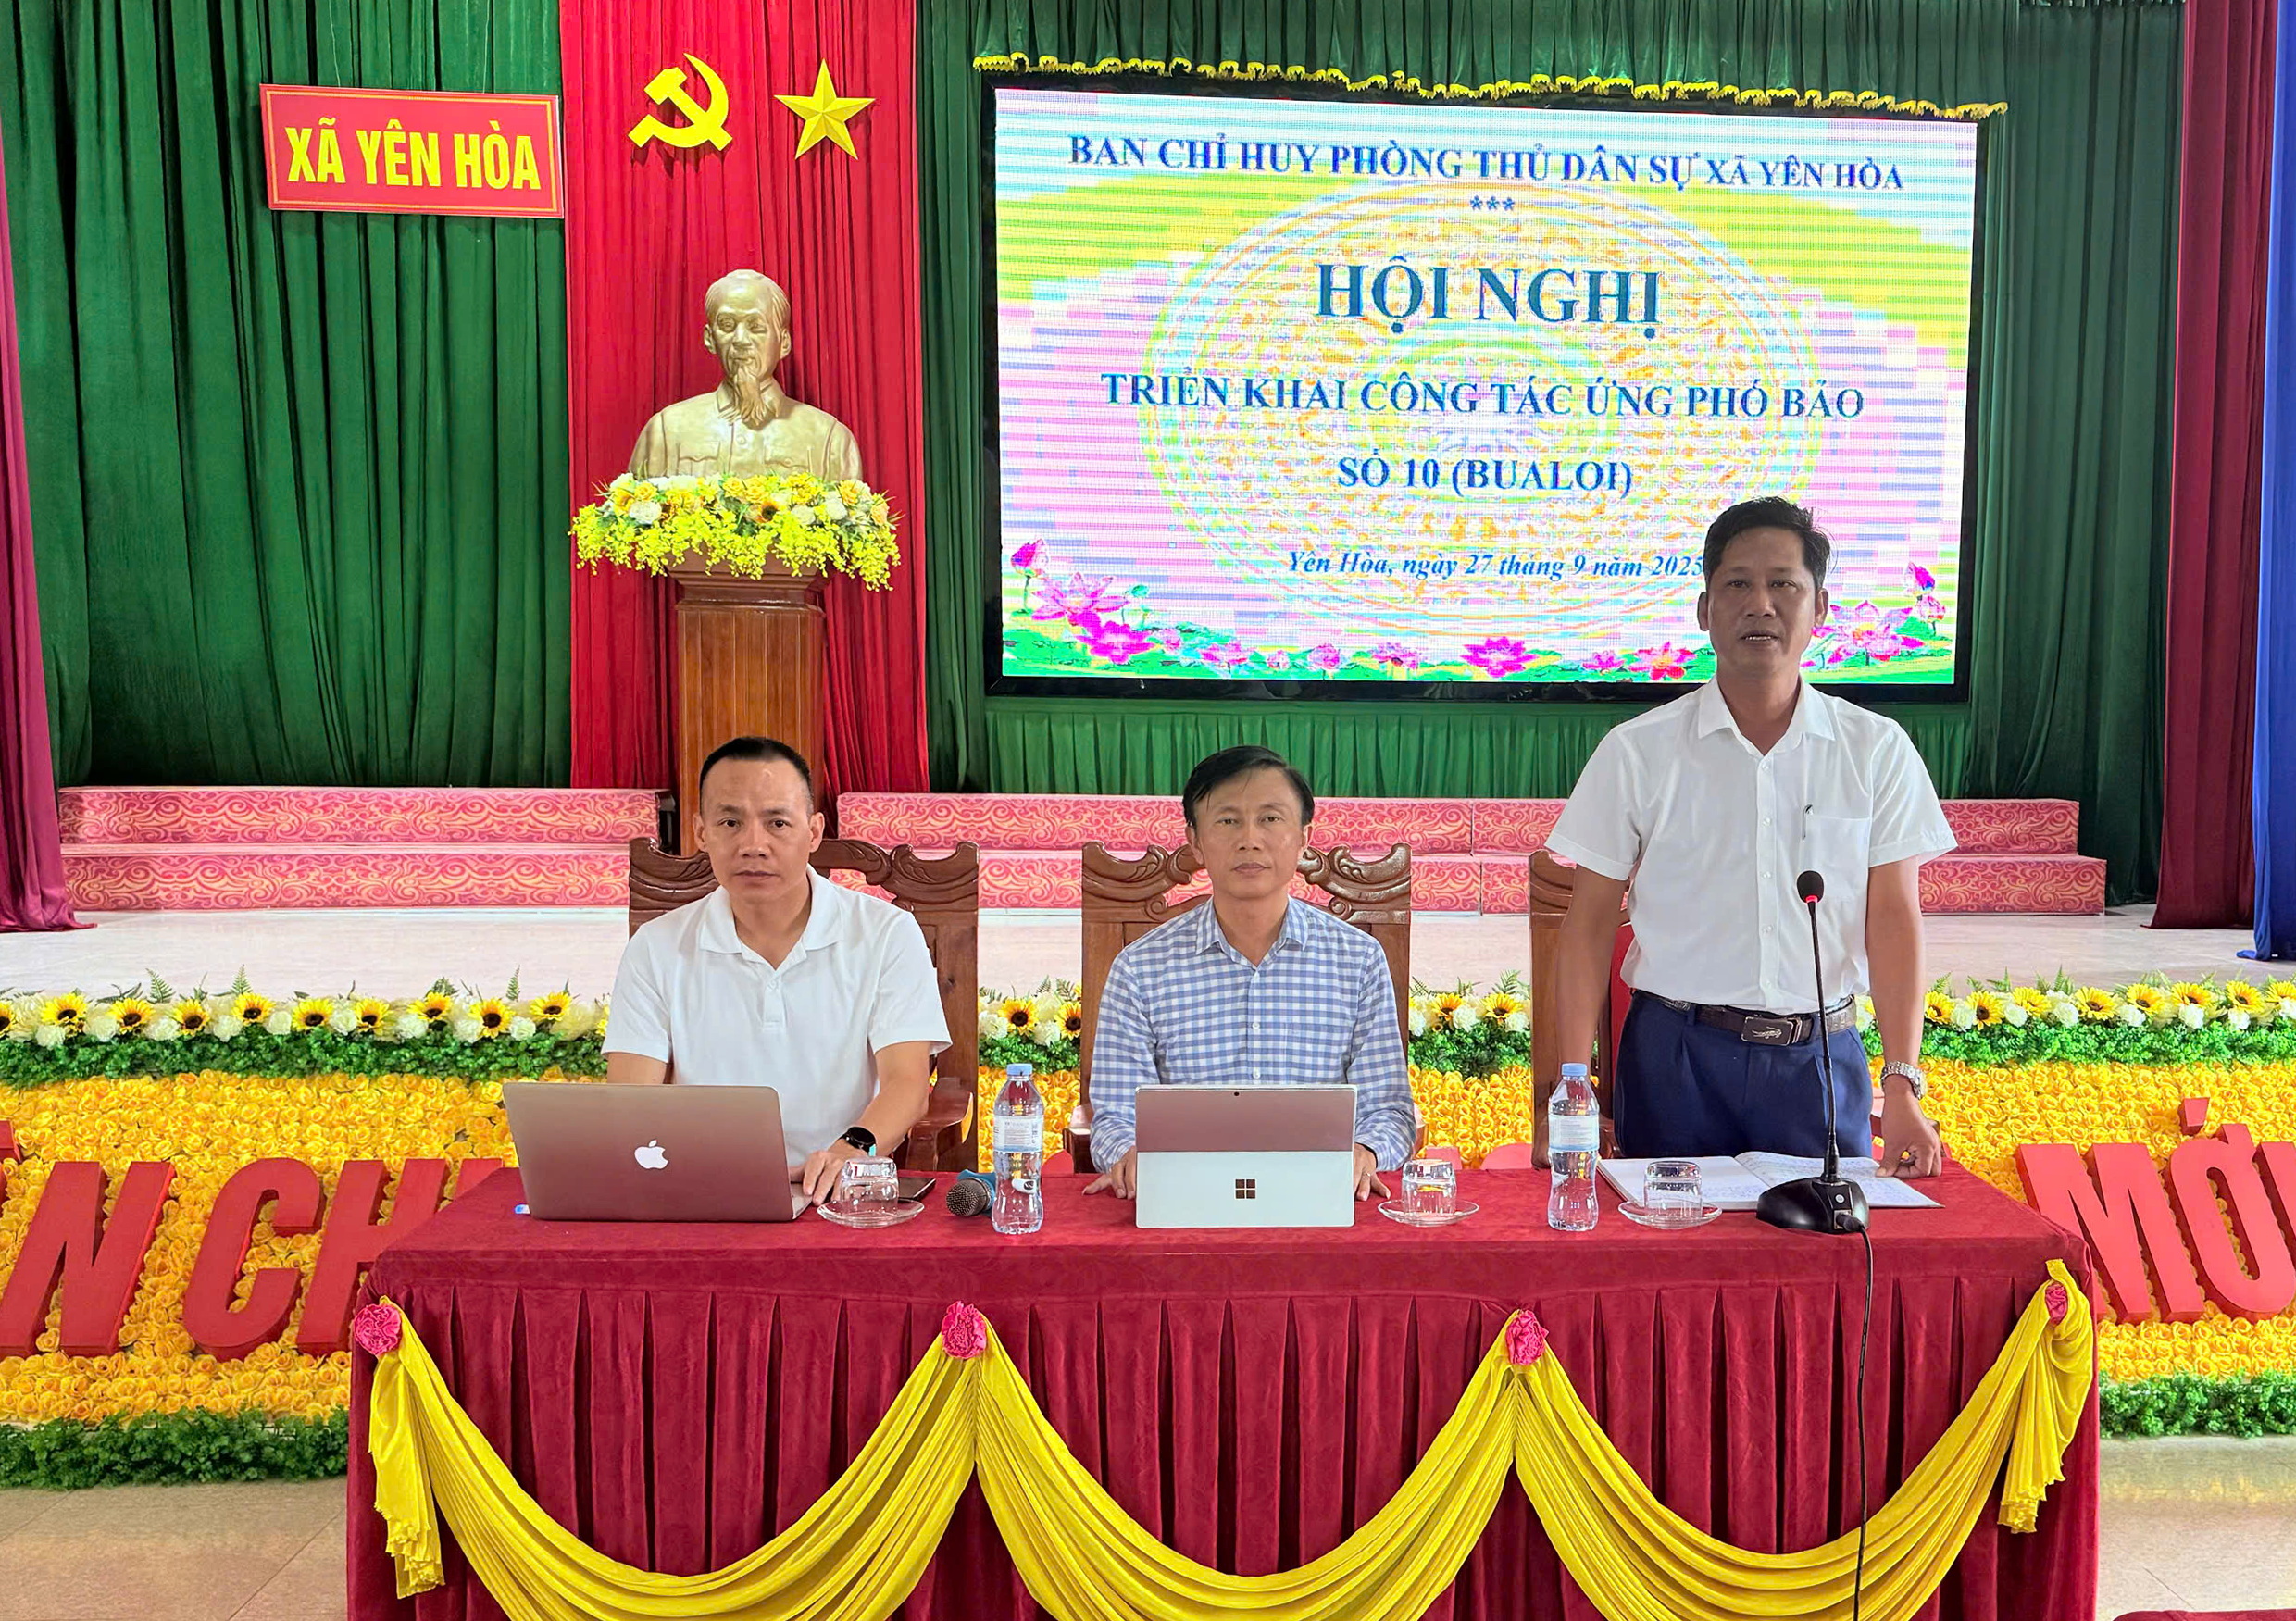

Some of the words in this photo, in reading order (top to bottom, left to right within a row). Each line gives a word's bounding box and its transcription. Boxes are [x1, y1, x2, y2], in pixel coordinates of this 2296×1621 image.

[285, 117, 346, 184] XÃ
[356, 118, 442, 187] YÊN
[454, 120, 542, 190] HÒA
[1068, 134, 1147, 167] BAN
[1158, 133, 1228, 170] CHỈ
[1238, 141, 1320, 173] HUY
[1329, 140, 1462, 179] PHÒNG
[1472, 143, 1550, 181] THỦ
[1561, 144, 1638, 183] DÂN
[1649, 152, 1701, 191] SỰ
[1706, 154, 1752, 186] XÃ
[1760, 155, 1828, 187] YÊN
[1834, 156, 1904, 190] HÒA
[1316, 255, 1460, 334] HỘI
[1473, 268, 1665, 341] NGHỊ
[1242, 378, 1349, 411] KHAI
[1360, 372, 1479, 414] CÔNG
[1490, 374, 1574, 417] TÁC
[1584, 376, 1674, 417] ỨNG
[1686, 378, 1770, 418] PHÓ
[1338, 448, 1391, 488] SỐ
[1404, 458, 1441, 489] 10
[1452, 458, 1633, 498] (BUALOI)
[1288, 550, 1331, 573] Yên
[1340, 551, 1394, 576] Hòa,
[1402, 553, 1458, 580] ngày
[1465, 554, 1493, 574] 27
[1498, 555, 1566, 582] tháng
[1573, 555, 1587, 576] 9
[1592, 556, 1643, 577] năm
[1650, 555, 1704, 577] 2025
[0, 1119, 176, 1356] N
[183, 1157, 509, 1363] CH
[2015, 1097, 2296, 1324] MỚ
